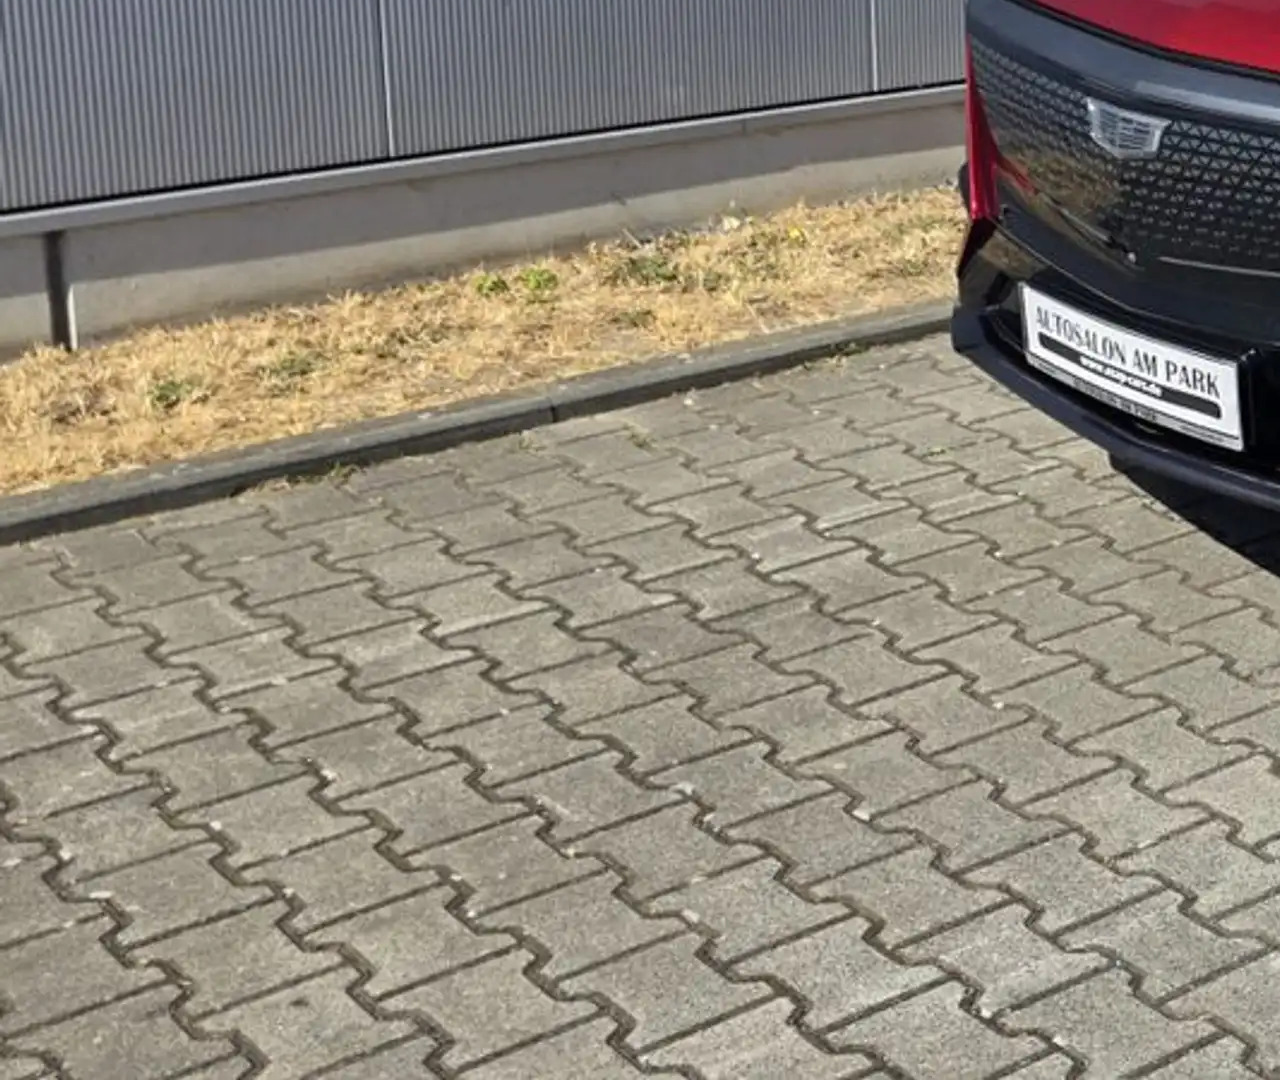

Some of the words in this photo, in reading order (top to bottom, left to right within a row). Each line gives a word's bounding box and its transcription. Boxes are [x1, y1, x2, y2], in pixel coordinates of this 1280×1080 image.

[1035, 306, 1127, 366] AUTOSALON
[1132, 348, 1158, 378] AM
[1165, 359, 1221, 399] PARK
